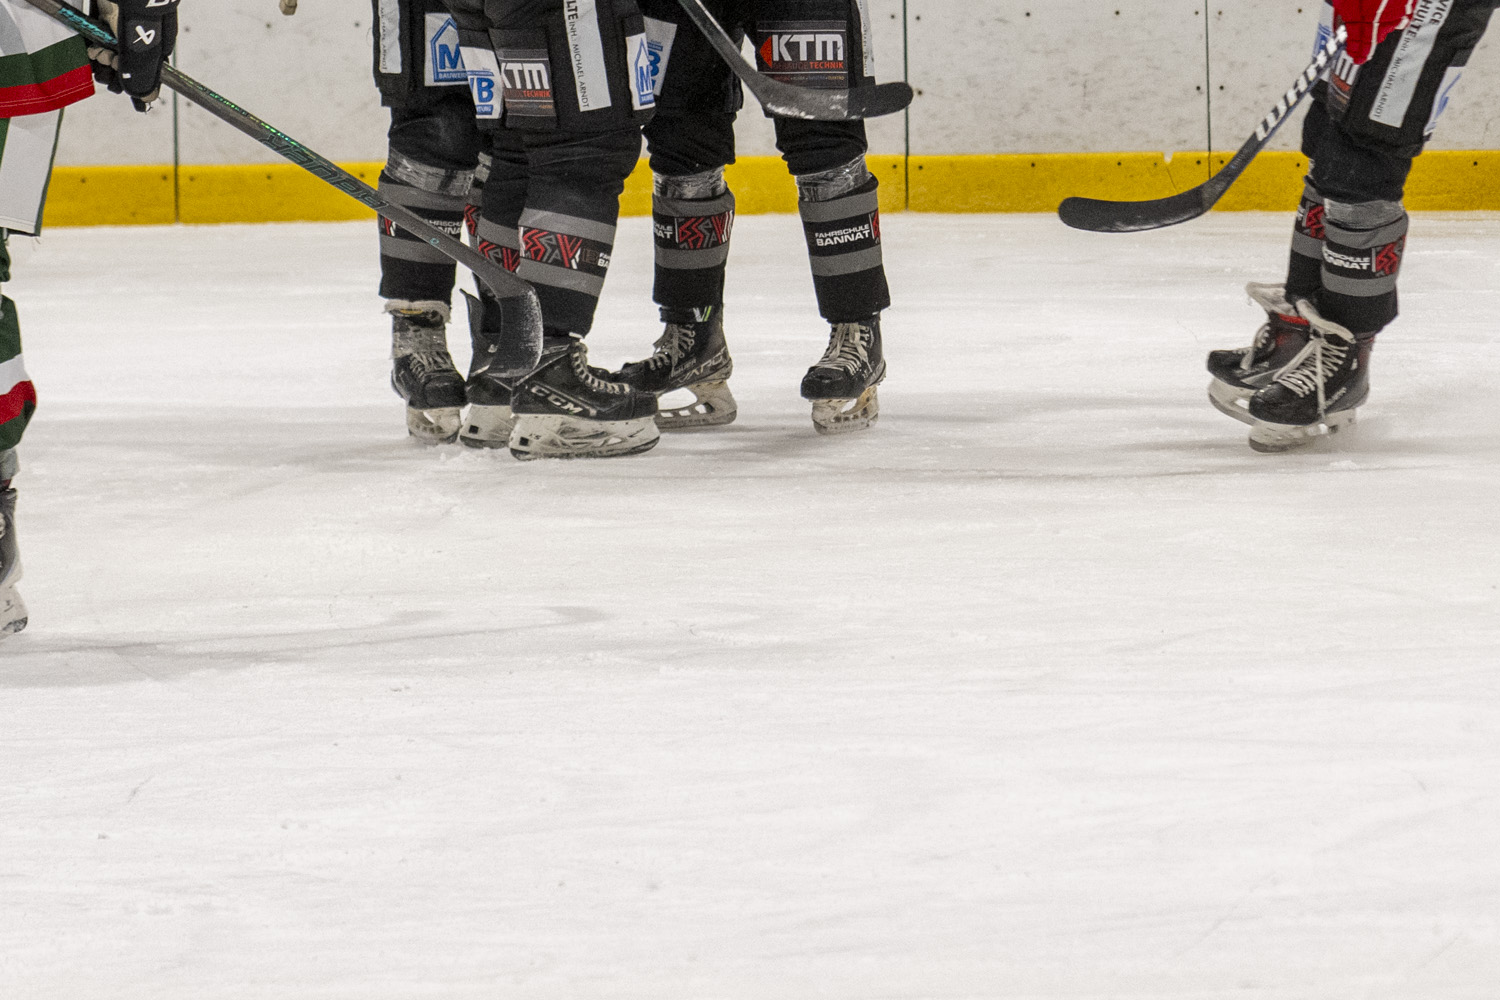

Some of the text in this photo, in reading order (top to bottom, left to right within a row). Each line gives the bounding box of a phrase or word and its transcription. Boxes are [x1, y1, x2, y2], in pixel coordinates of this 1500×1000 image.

[771, 33, 845, 62] KTM
[809, 61, 844, 70] TECHNIK
[814, 223, 871, 239] FAHRSCHULE
[816, 229, 872, 247] BANNAT
[530, 384, 584, 415] CCM
